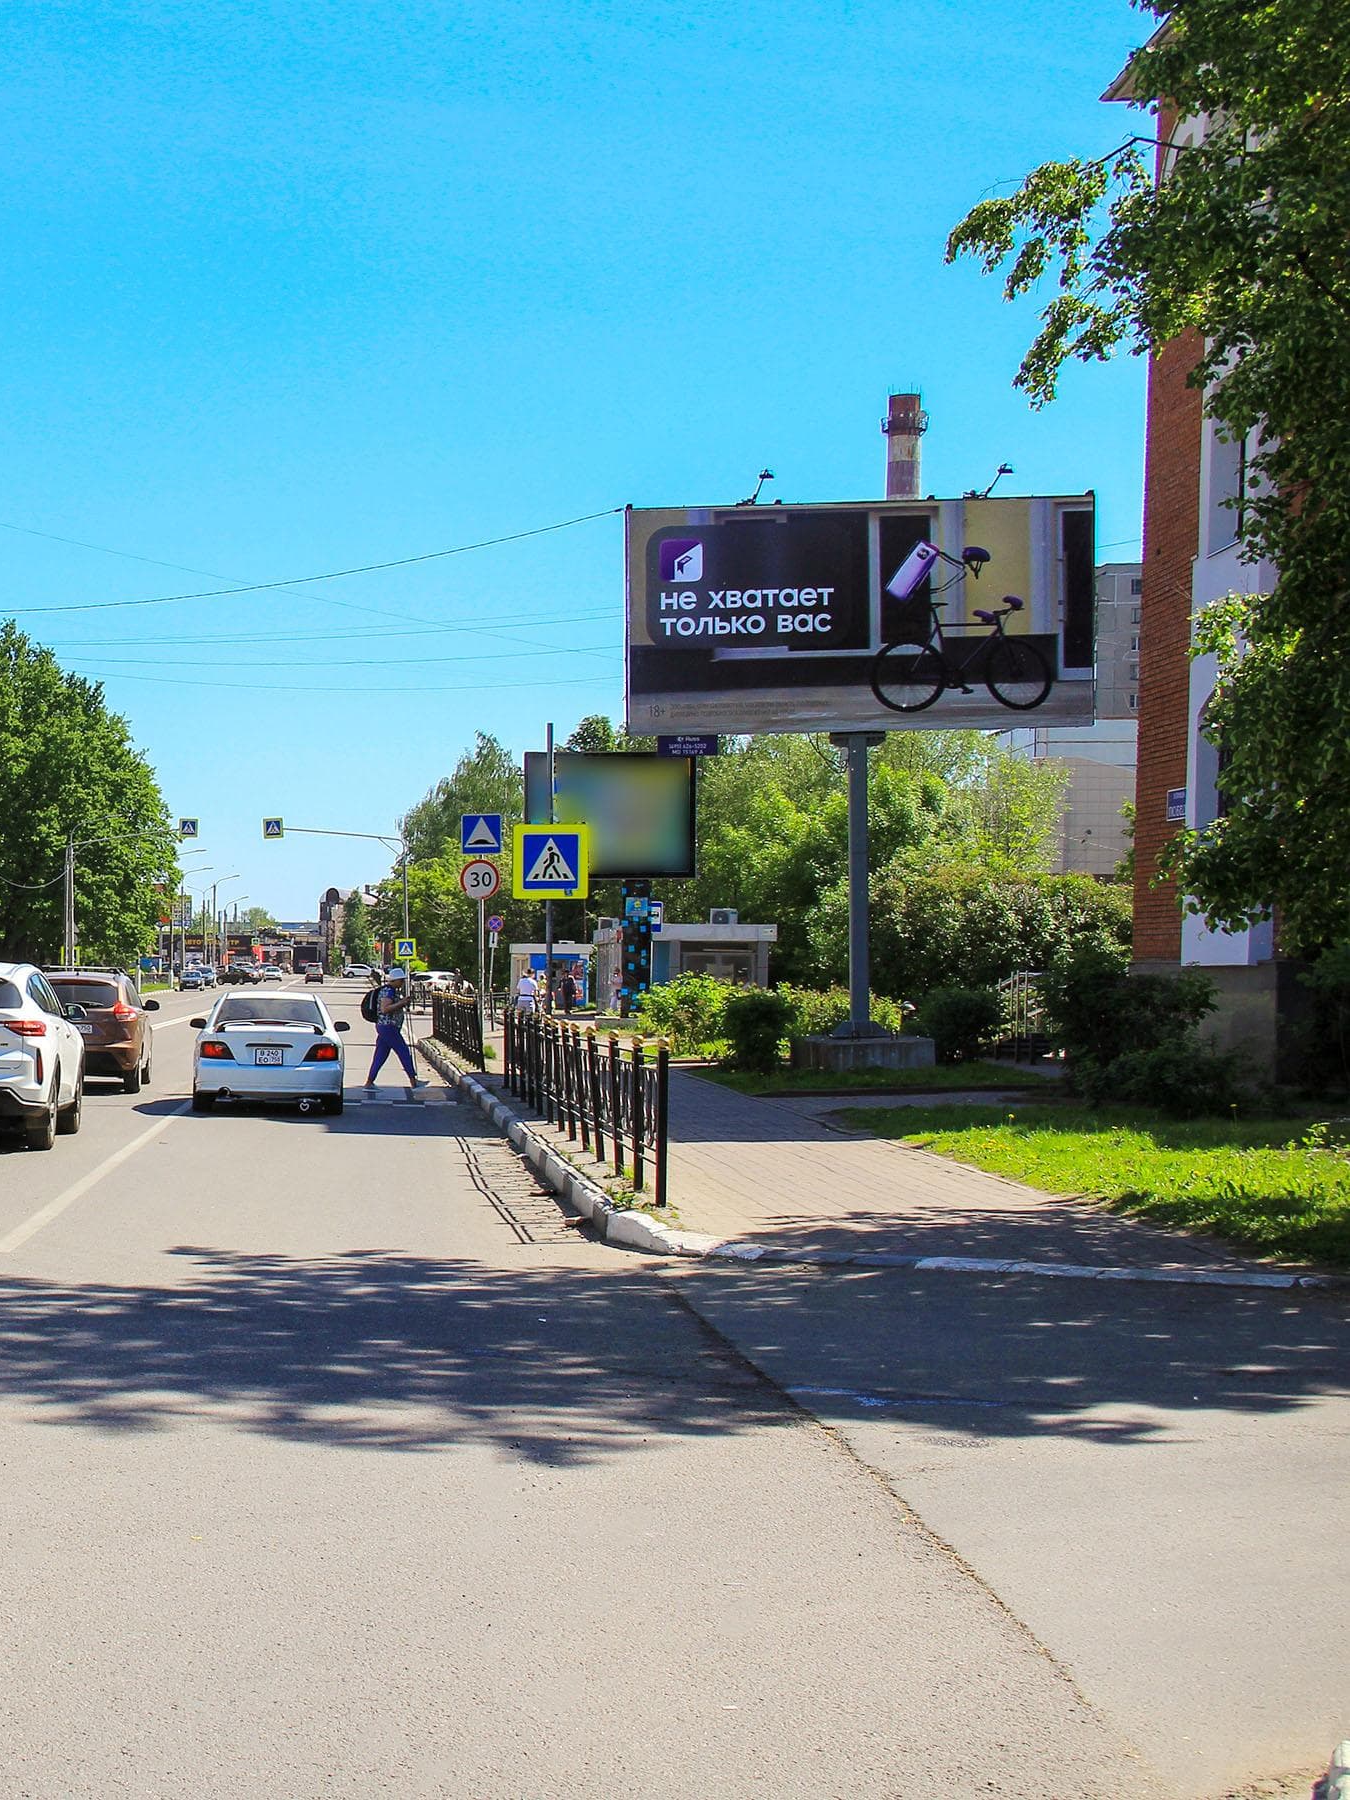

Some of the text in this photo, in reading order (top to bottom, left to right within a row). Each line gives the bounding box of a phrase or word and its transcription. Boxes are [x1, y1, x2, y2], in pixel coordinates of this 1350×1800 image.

[660, 587, 835, 611] не хватает
[659, 613, 832, 637] только вас
[650, 704, 666, 718] 18+
[470, 871, 492, 888] 30
